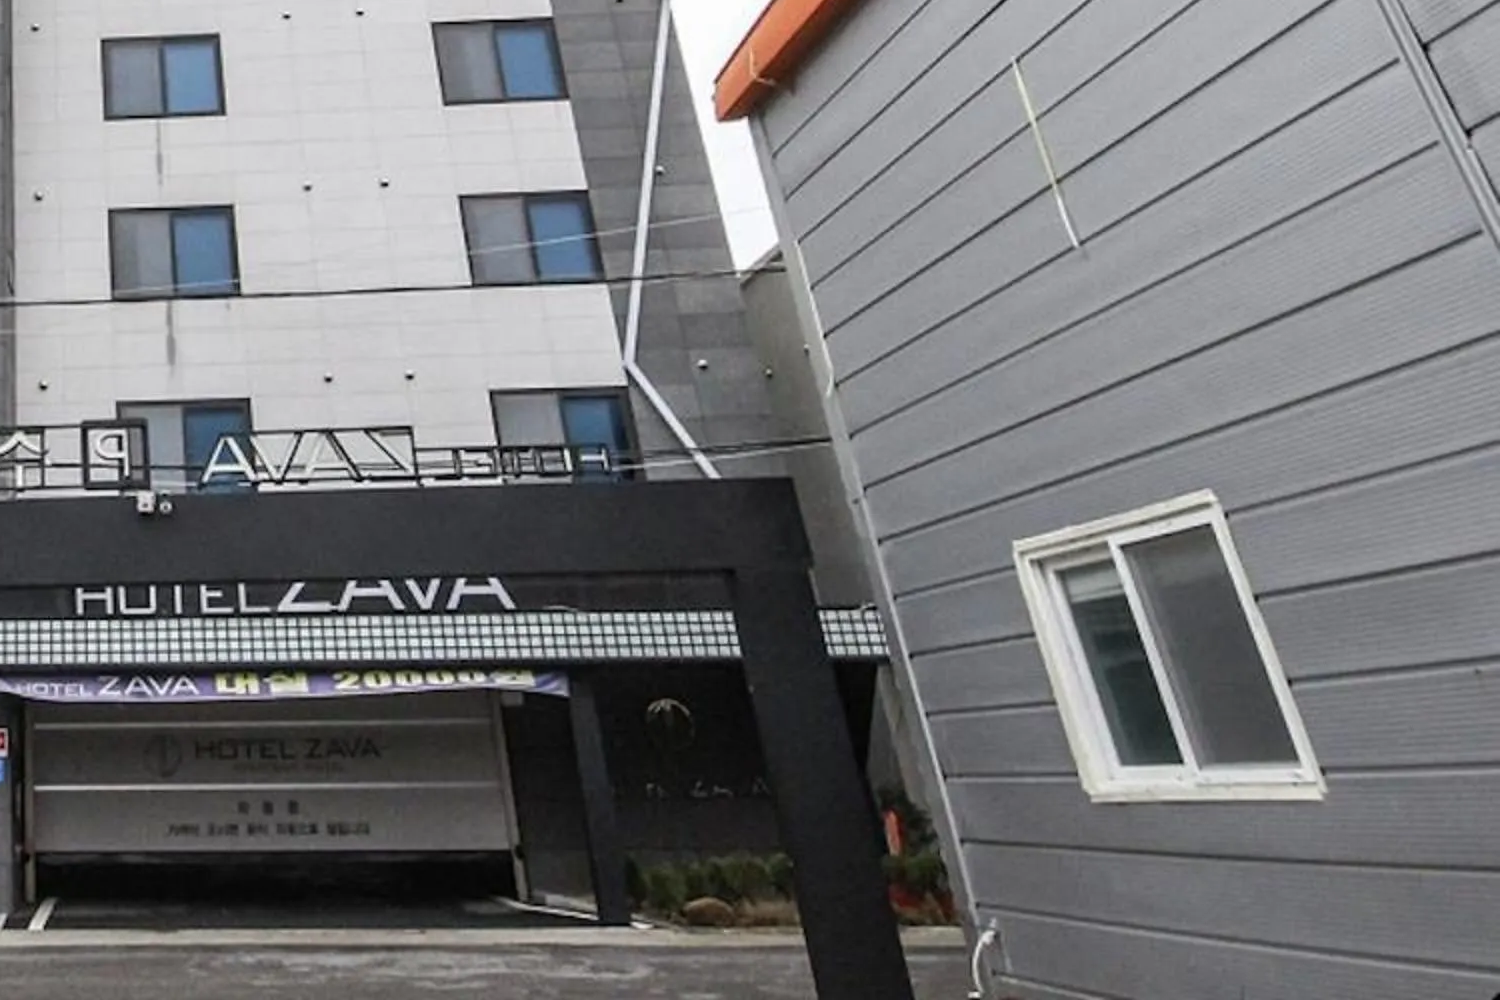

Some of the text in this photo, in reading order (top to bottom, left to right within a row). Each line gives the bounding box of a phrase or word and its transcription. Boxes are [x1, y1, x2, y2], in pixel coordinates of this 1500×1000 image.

[15, 681, 93, 698] HOTEL
[98, 675, 200, 698] ZAVA
[194, 737, 383, 761] HOTEL ZAVA
